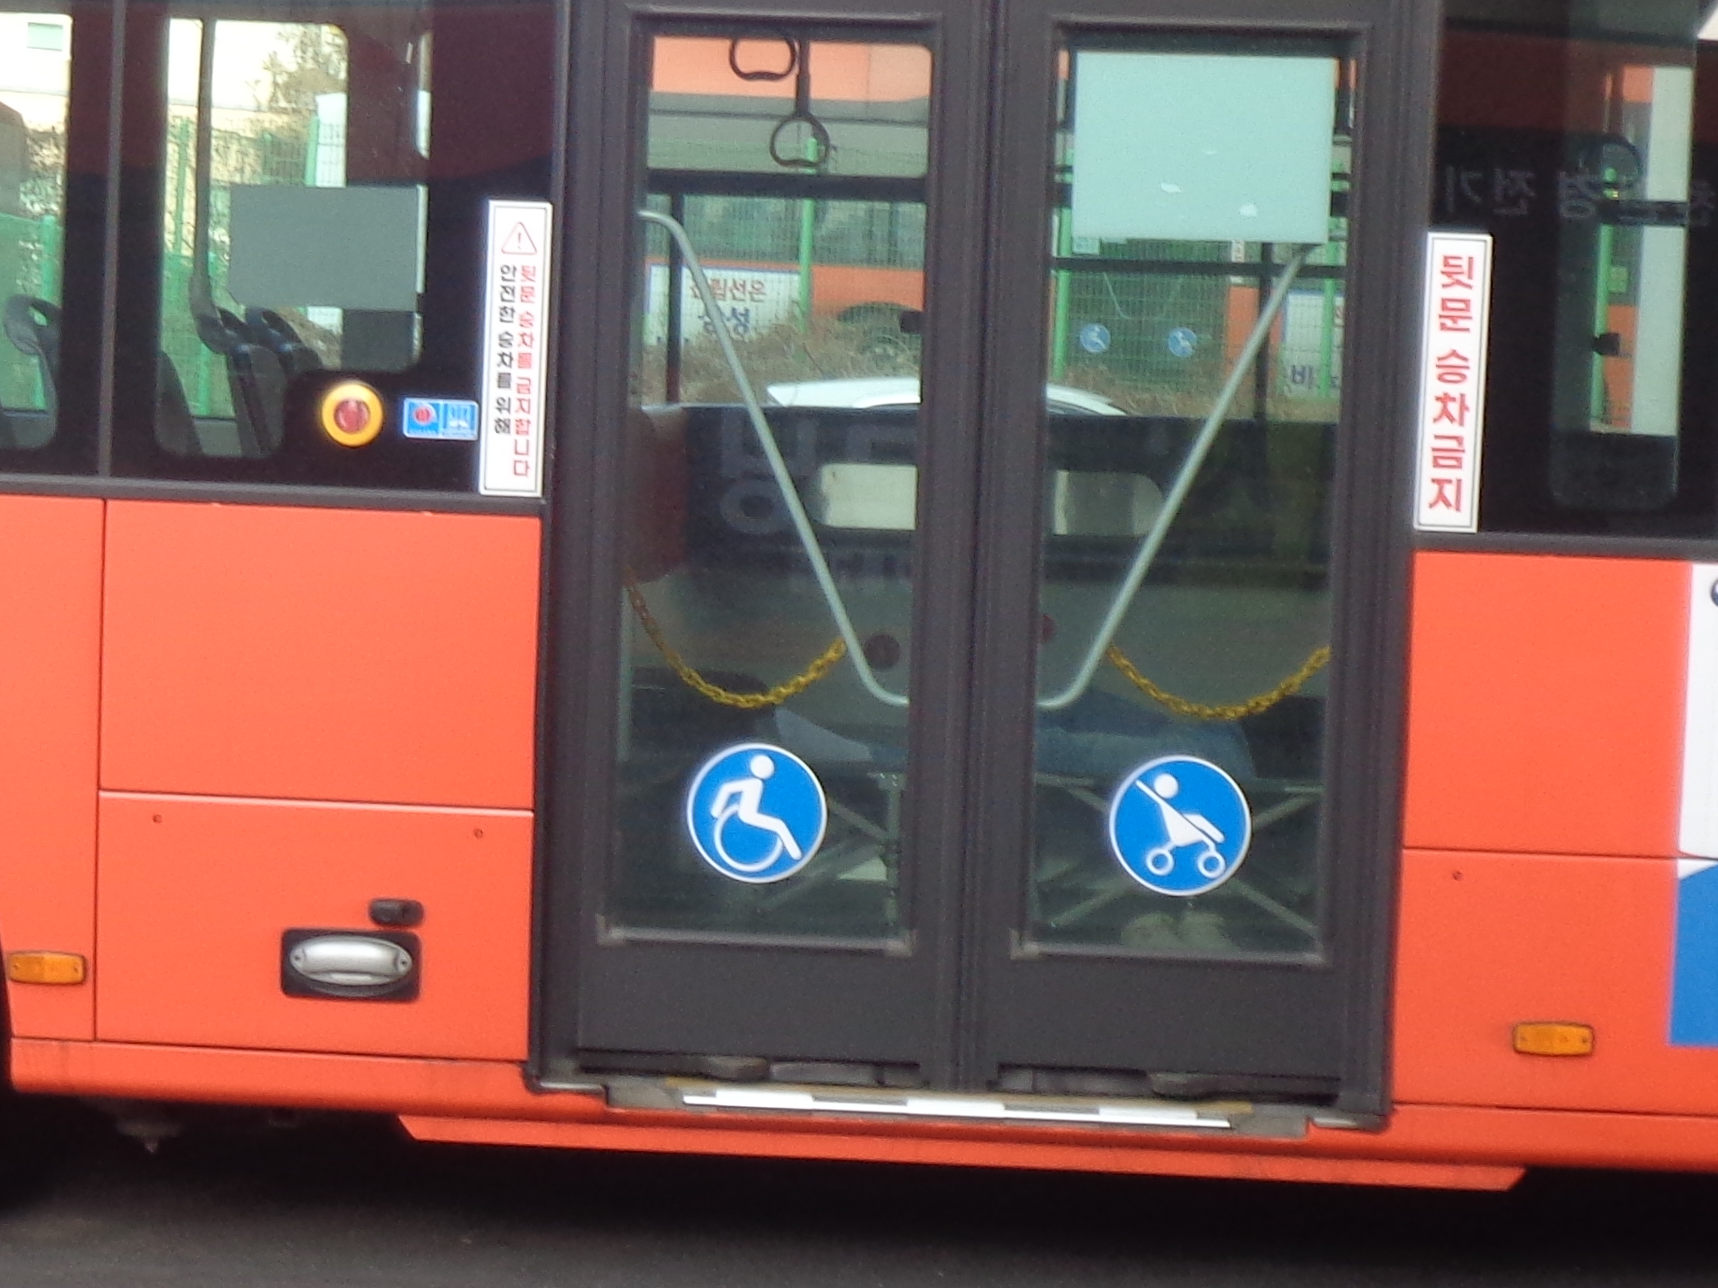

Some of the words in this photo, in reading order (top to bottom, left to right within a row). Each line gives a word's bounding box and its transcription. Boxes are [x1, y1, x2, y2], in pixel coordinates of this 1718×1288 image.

[499, 265, 517, 324] 안전한
[1439, 254, 1474, 334] 뒷문
[496, 330, 514, 390] 승차를
[517, 310, 535, 369] 승차를
[513, 376, 532, 478] 금지합니다
